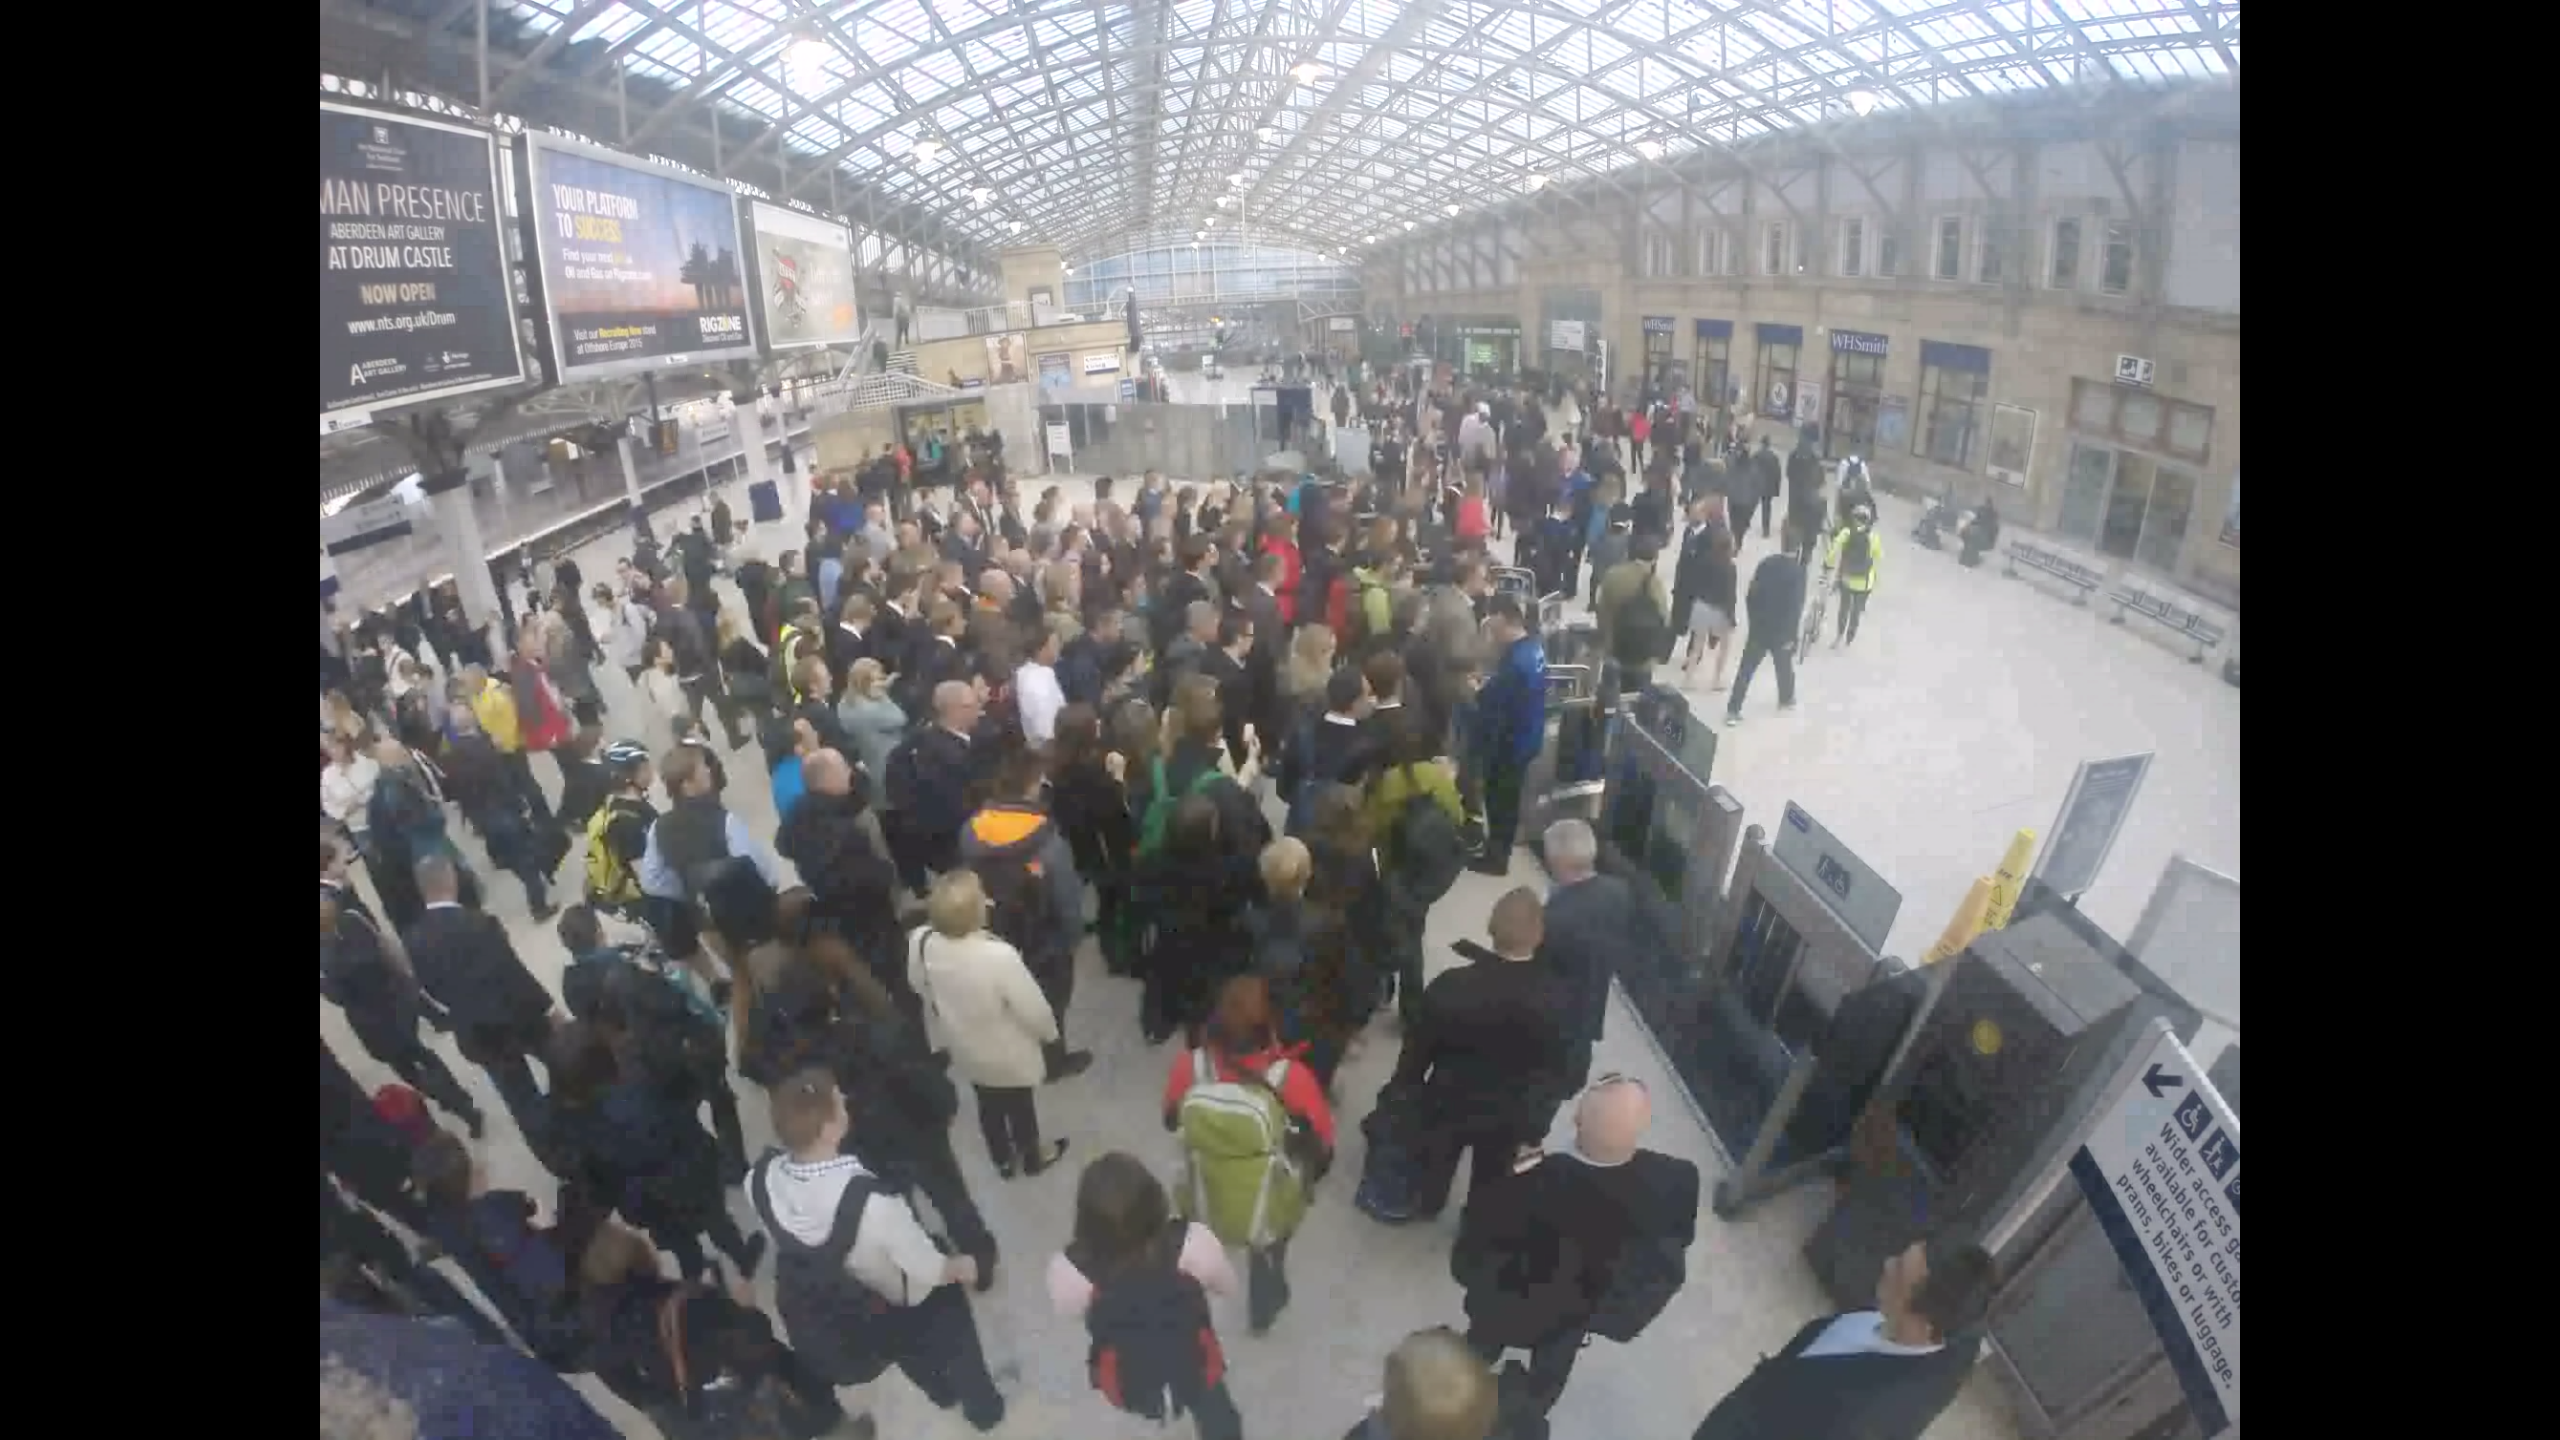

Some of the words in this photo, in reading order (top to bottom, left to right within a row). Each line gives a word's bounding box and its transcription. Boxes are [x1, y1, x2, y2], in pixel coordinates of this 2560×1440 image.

[378, 183, 485, 222] PRESENCE
[553, 184, 585, 212] YOUR
[586, 190, 639, 220] PLATFORM
[331, 223, 386, 240] ABERDEEN
[388, 225, 405, 239] ART
[406, 225, 445, 240] GALLERY
[556, 213, 573, 238] TO
[575, 215, 622, 243] SUCCESS
[329, 247, 347, 269] AT
[351, 246, 401, 269] DRUM
[404, 247, 454, 268] CASTLE
[361, 283, 397, 304] NOW
[400, 282, 436, 302] OPEN
[347, 311, 456, 334] www.nts.org.uk/Drum
[699, 315, 742, 333] RIGZONE
[609, 340, 629, 351] Europe
[629, 338, 643, 349] 2015
[1832, 334, 1889, 354] WHSmith
[362, 358, 397, 370] ABERDEEN
[363, 367, 377, 378] ART
[378, 364, 407, 376] GALLERY
[2160, 1122, 2196, 1176] Wider
[2192, 1178, 2232, 1237] access
[2145, 1143, 2195, 1221] available
[2193, 1219, 2214, 1249] for
[2210, 1252, 2240, 1309] custo
[2132, 1158, 2196, 1262] wheelchairs
[2191, 1263, 2208, 1283] or
[2203, 1284, 2232, 1330] with
[2116, 1173, 2152, 1234] prams,
[2152, 1230, 2183, 1284] bikes
[2179, 1284, 2195, 1304] or
[2190, 1303, 2232, 1389] luggage.
